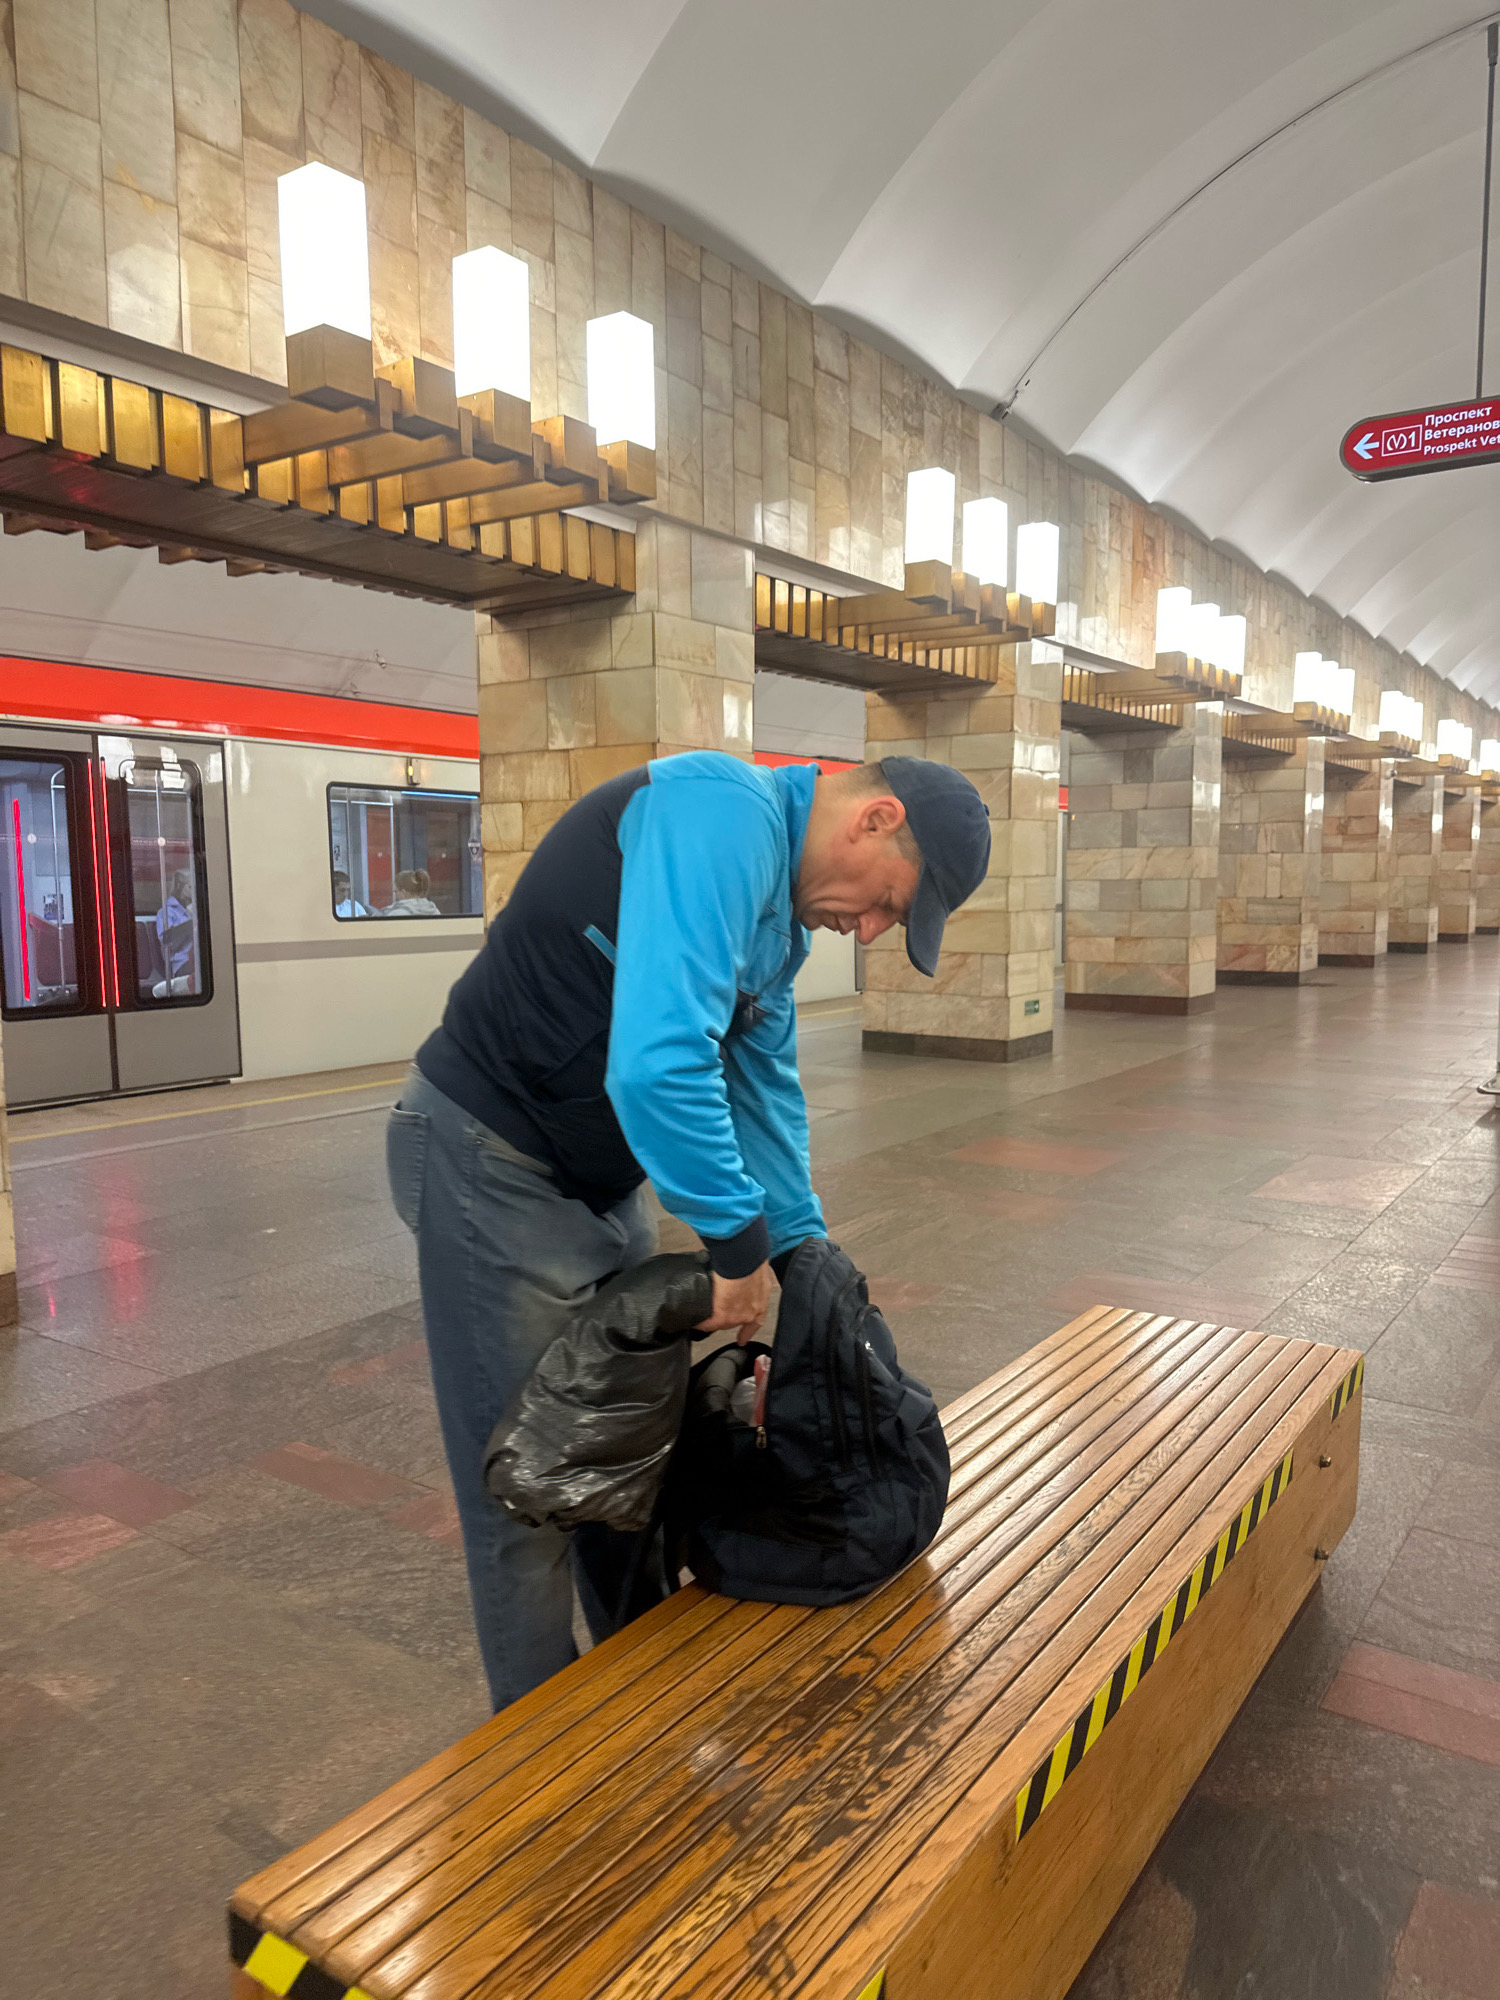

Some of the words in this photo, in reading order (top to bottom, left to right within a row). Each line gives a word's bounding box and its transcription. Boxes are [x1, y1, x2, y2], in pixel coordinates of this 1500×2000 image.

[1425, 406, 1493, 427] Проспект
[1424, 420, 1500, 440] Ветеранов
[1423, 438, 1478, 456] Prospekt
